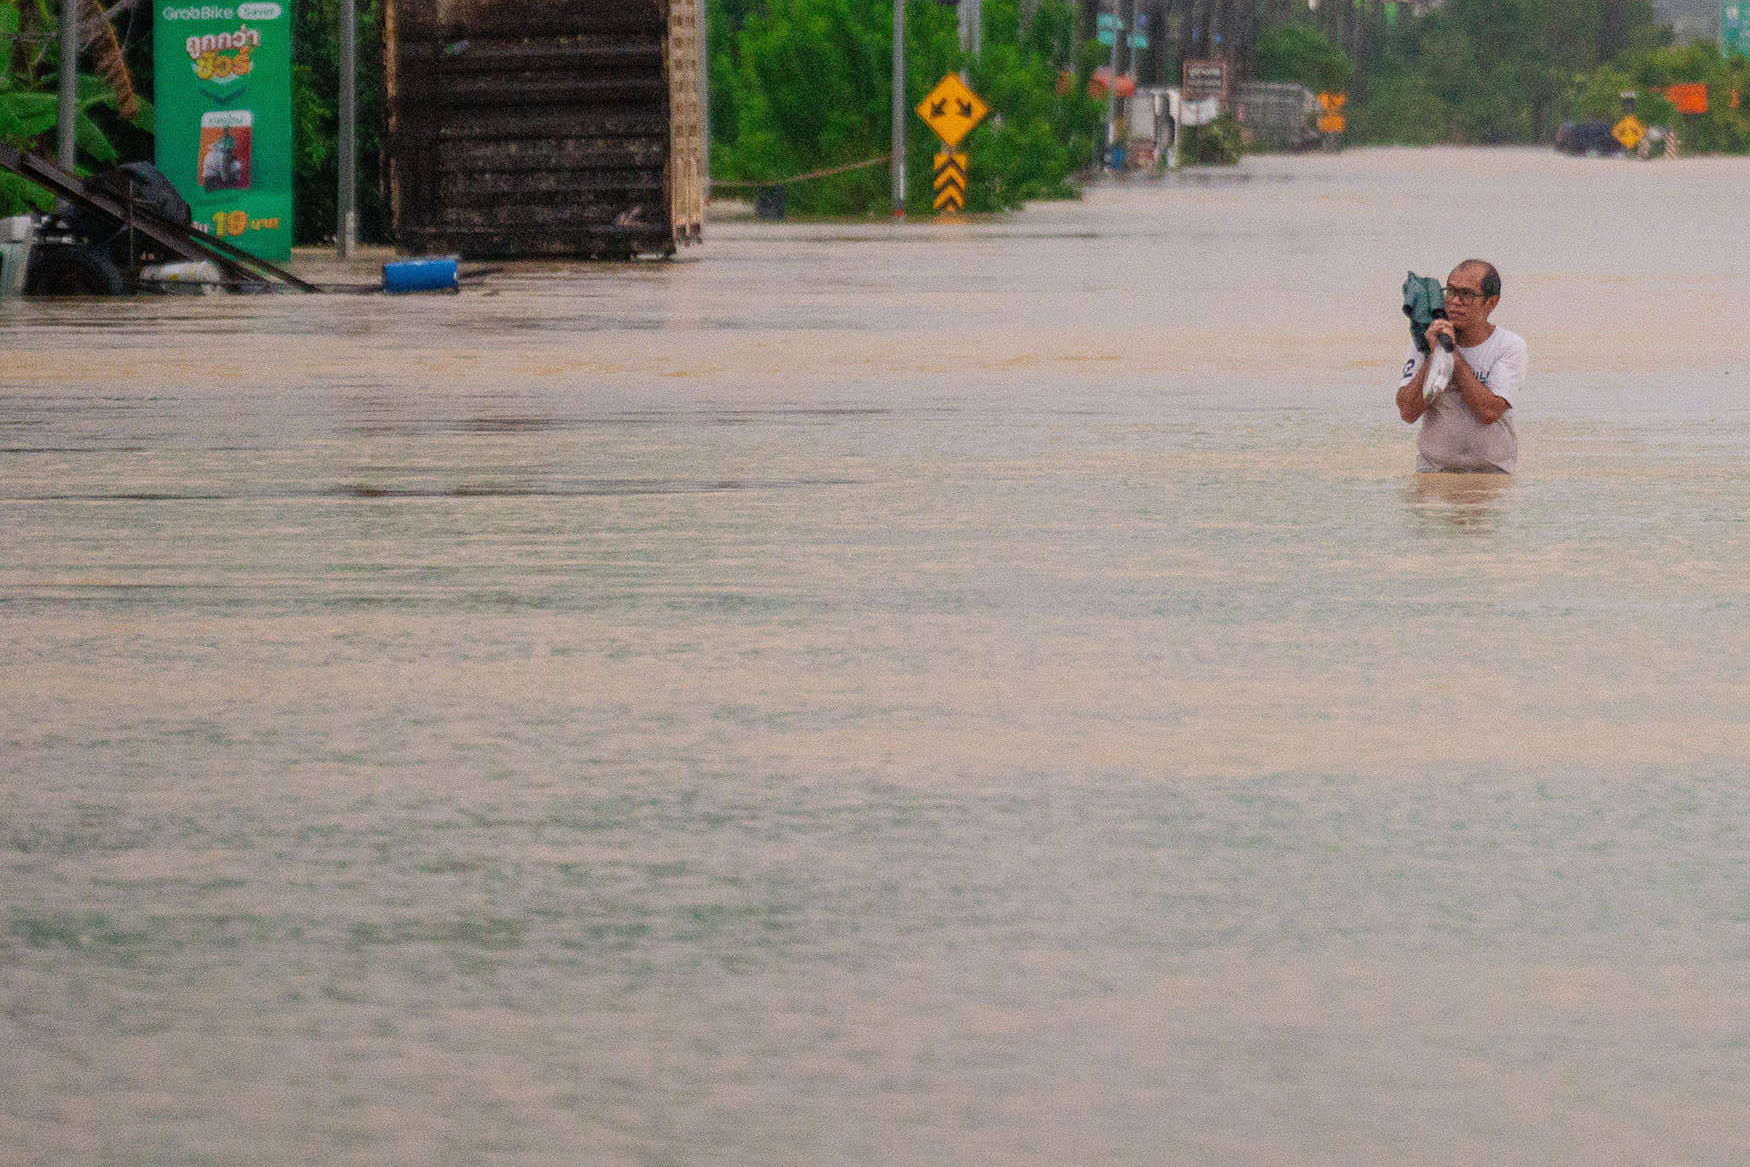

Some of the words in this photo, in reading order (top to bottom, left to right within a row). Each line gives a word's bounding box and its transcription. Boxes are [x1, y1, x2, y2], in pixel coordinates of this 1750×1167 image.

[163, 5, 235, 21] GrabBike
[185, 24, 260, 60] ถูกกว่า
